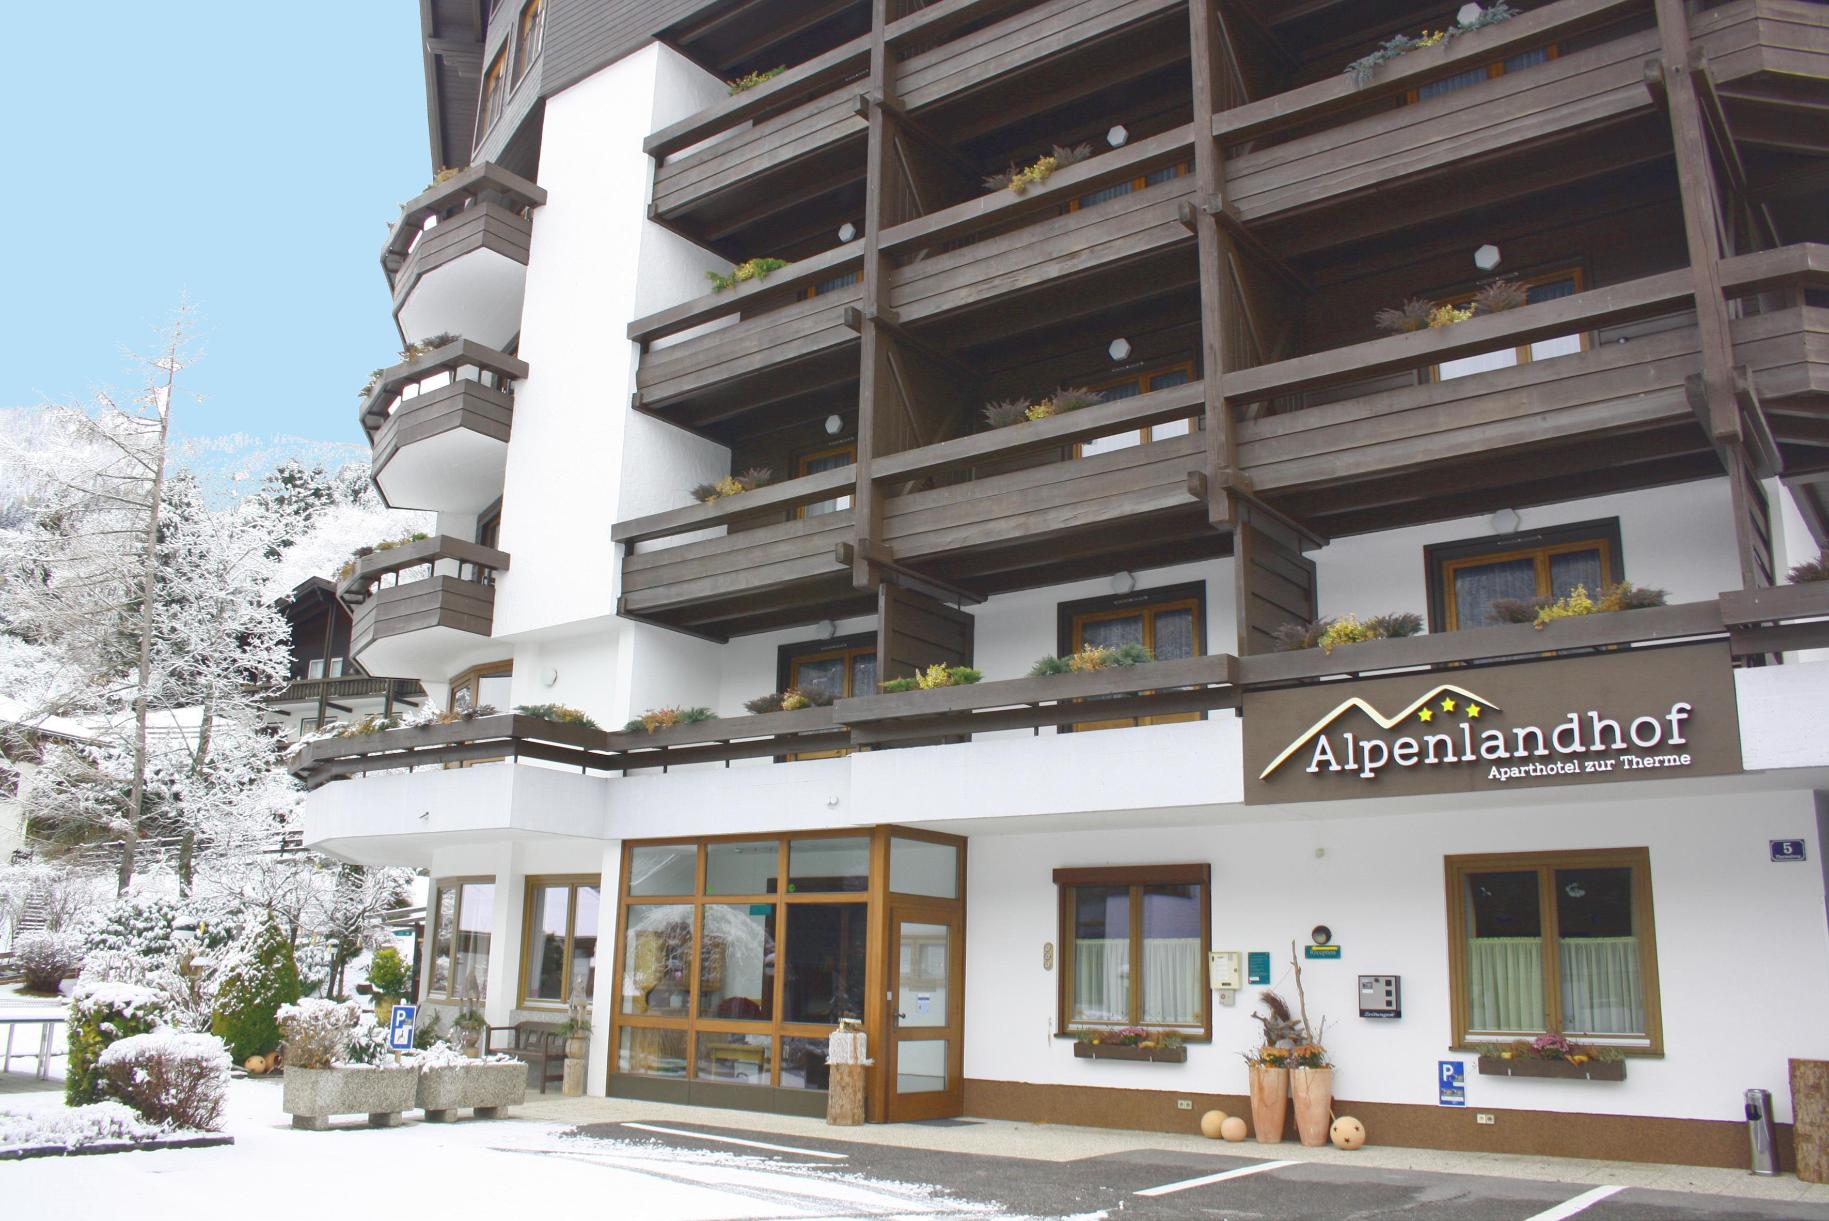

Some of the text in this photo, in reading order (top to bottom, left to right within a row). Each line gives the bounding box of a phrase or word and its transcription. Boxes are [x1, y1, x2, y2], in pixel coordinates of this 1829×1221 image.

[1305, 702, 1692, 779] Alpenlandhof
[1487, 753, 1692, 782] Aparthotel zur Therme
[1783, 842, 1793, 855] 5
[395, 1010, 406, 1027] P
[1442, 1063, 1454, 1082] P
